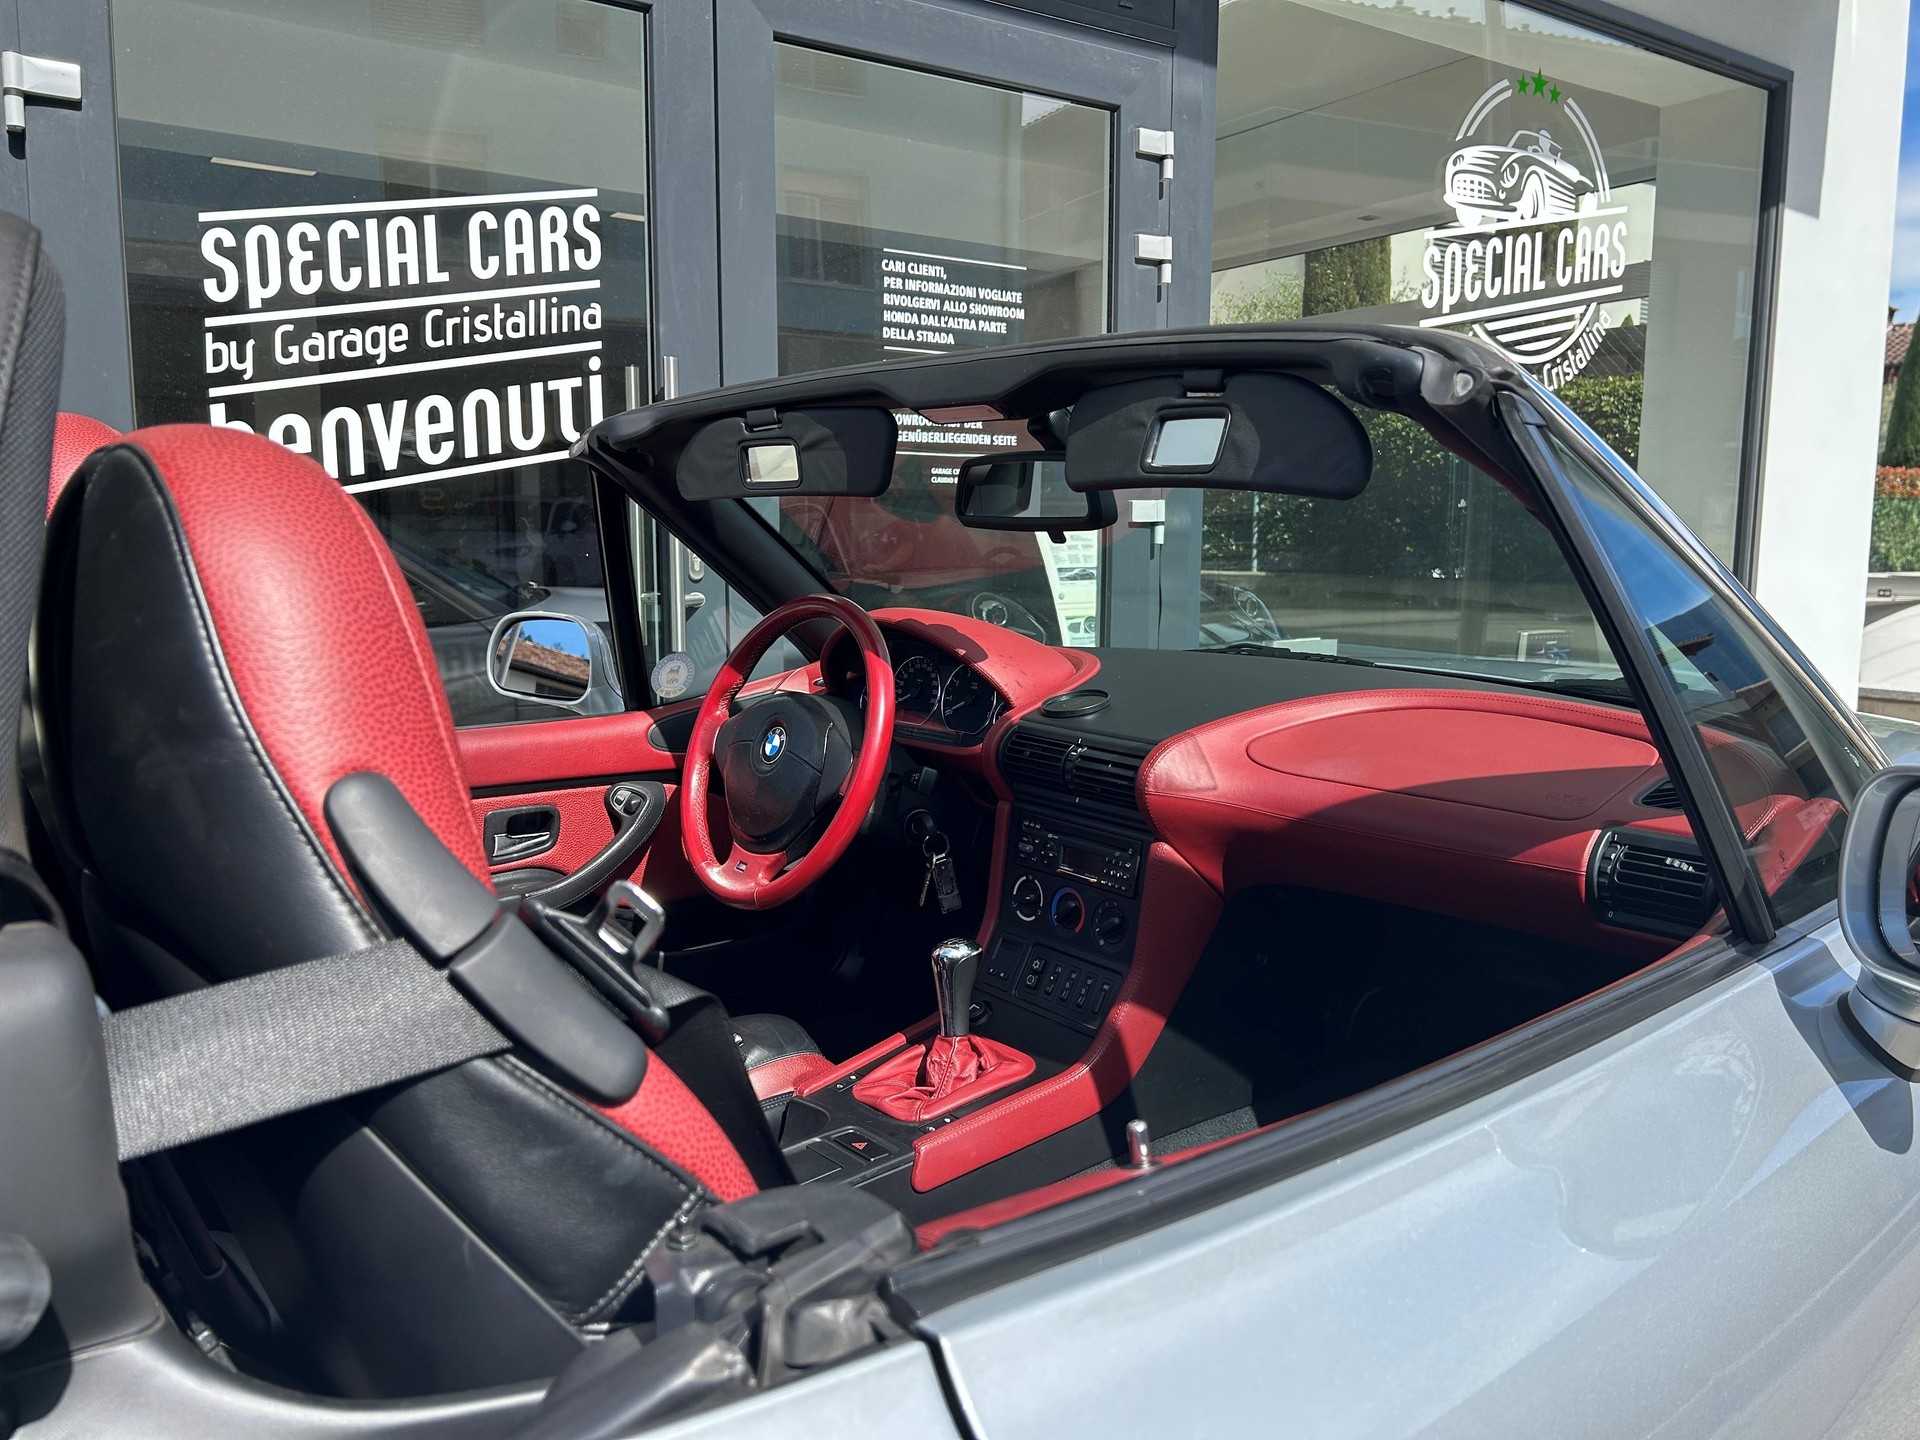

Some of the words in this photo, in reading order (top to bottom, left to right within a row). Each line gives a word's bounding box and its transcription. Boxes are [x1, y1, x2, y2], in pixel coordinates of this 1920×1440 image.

[201, 213, 450, 309] SPECIAL
[468, 204, 602, 280] CARS
[881, 259, 906, 273] CARI
[907, 262, 947, 280] CLIENTI,
[1421, 231, 1546, 314] SPECIAL
[1556, 221, 1628, 288] CARS
[883, 276, 903, 289] PER
[905, 278, 977, 299] INFORMAZIONI
[978, 287, 1023, 304] VOGLIATE
[883, 293, 941, 311] RIVOLGERVI
[943, 300, 968, 314] ALLO
[969, 303, 1025, 320] SHOWROOM
[882, 326, 915, 341] DELLA
[916, 330, 955, 345] STRADA
[883, 310, 919, 325] HONDA
[920, 314, 977, 331] DALL'ALTRA
[978, 320, 1007, 334] PARTE
[204, 331, 256, 381] by
[274, 321, 409, 365] Garage
[424, 296, 602, 349] Cristallina
[1543, 309, 1612, 392] Cristallina
[992, 434, 1018, 446] SEITE
